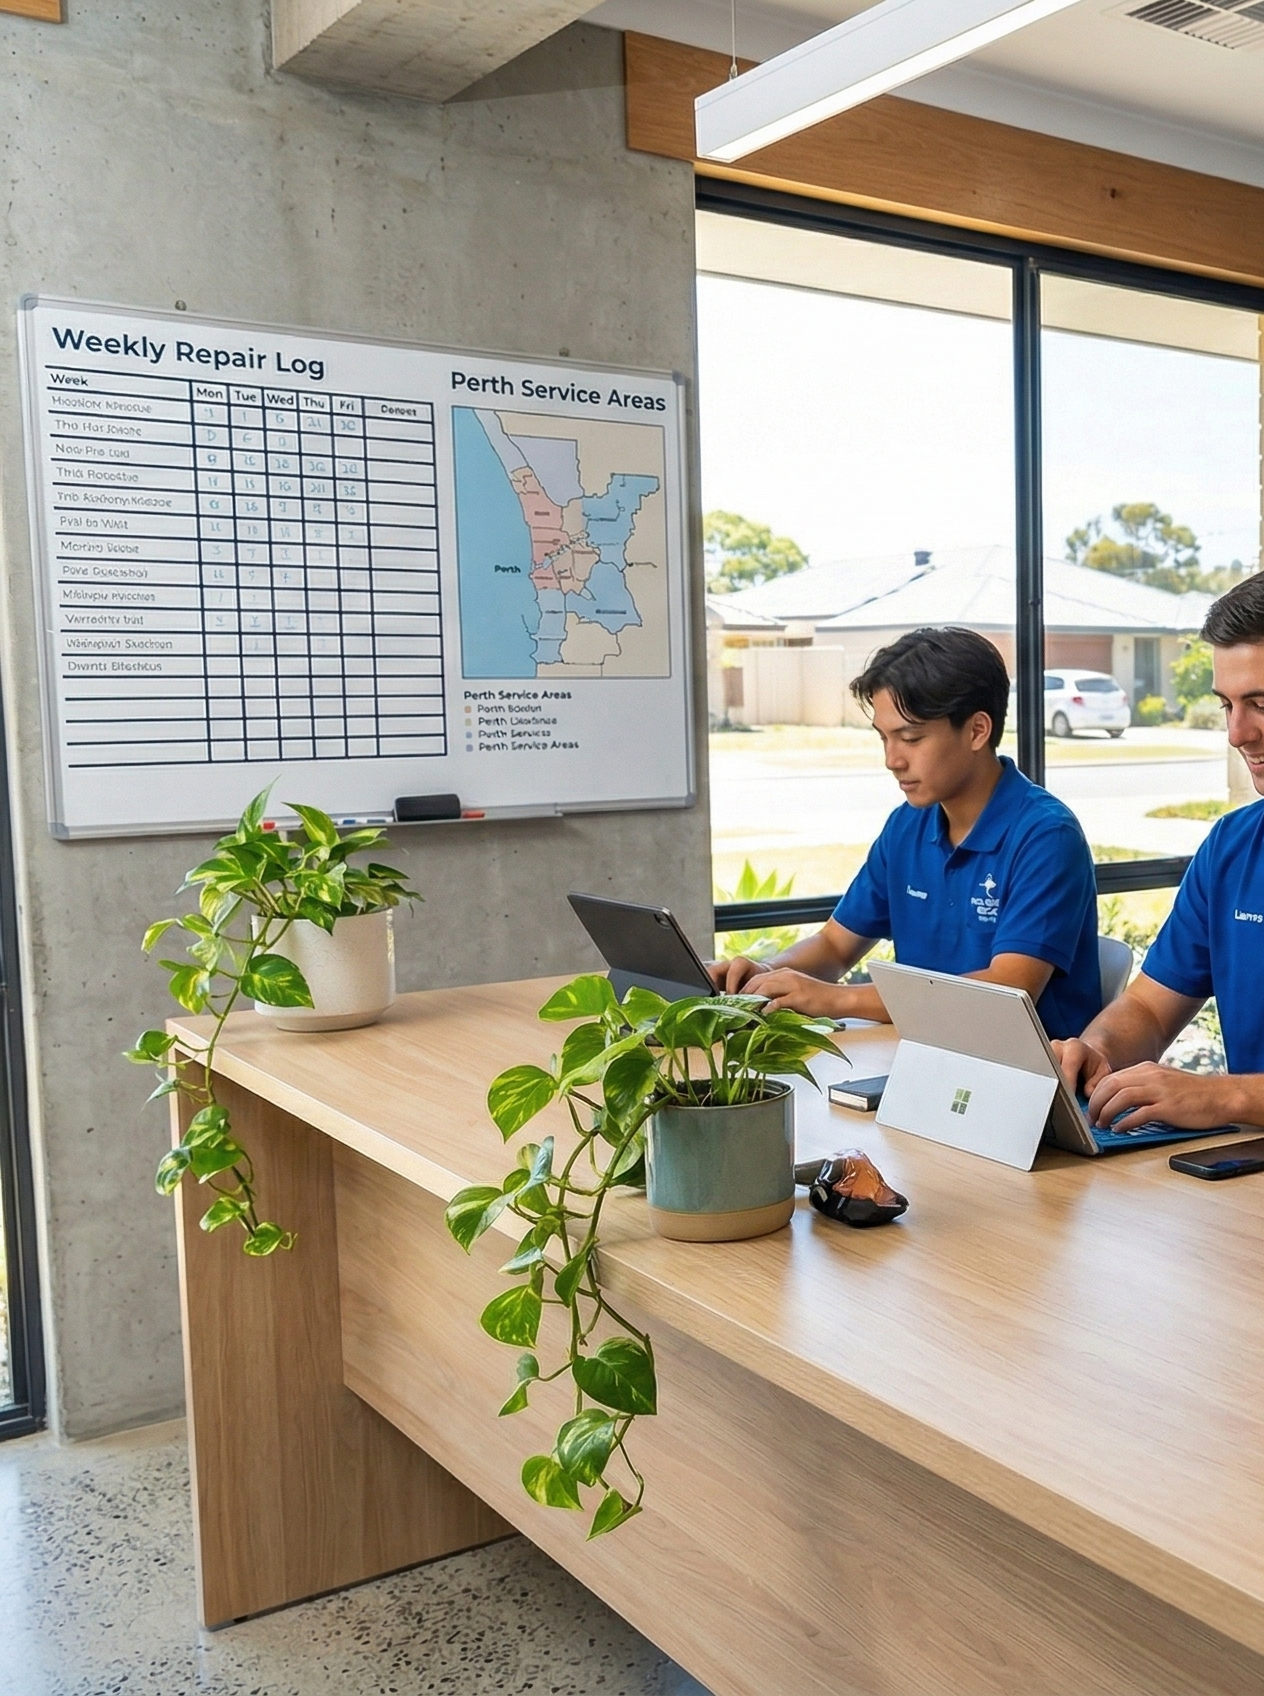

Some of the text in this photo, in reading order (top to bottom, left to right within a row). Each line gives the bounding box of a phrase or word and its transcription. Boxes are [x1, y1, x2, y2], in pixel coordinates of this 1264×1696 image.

[52, 326, 325, 380] Weekly Repair Log
[51, 374, 88, 387] Week
[451, 371, 667, 411] Perth Service Areas
[197, 387, 223, 399] Mon
[235, 390, 257, 402] Tue
[267, 393, 295, 406] Wed
[303, 397, 325, 409] Thu
[464, 689, 572, 700] Perth Service Areas
